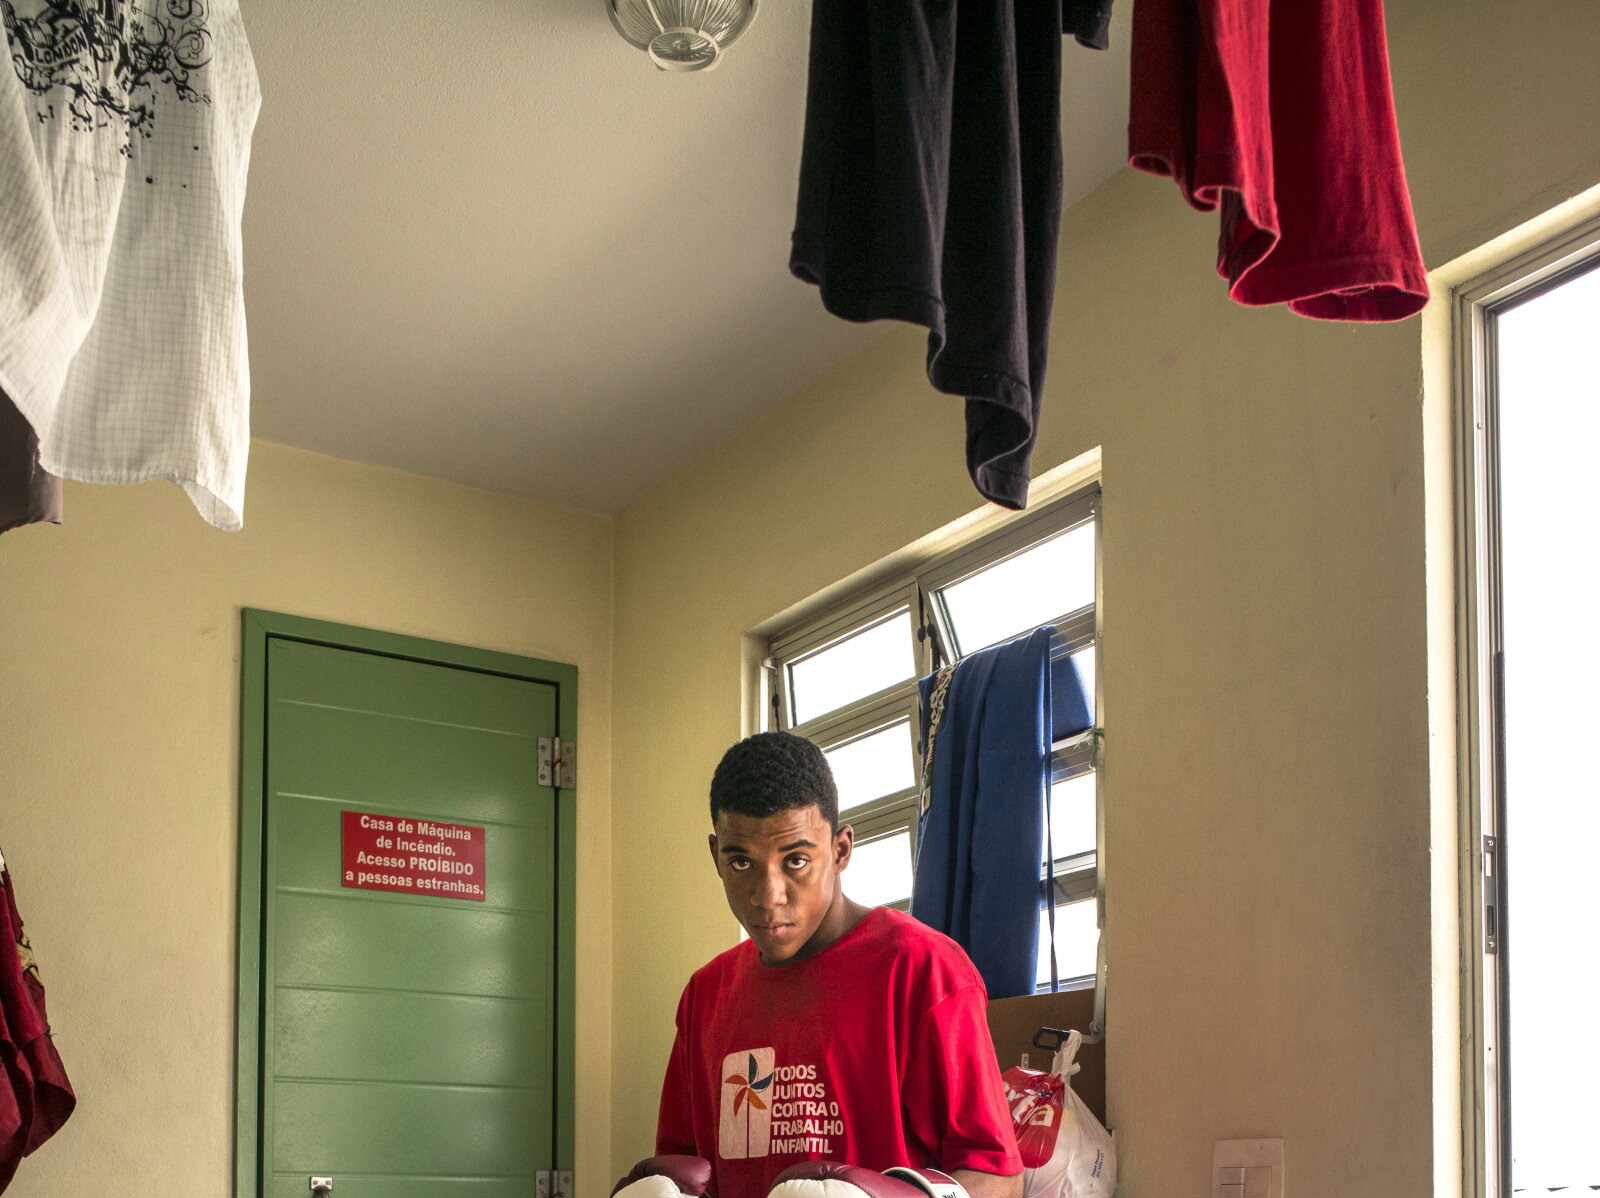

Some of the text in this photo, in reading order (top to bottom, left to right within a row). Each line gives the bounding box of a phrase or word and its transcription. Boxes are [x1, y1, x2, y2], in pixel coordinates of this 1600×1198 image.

[35, 30, 88, 63] LONDON
[360, 815, 471, 841] Casa de Máquina
[376, 835, 456, 856] de Incêndio.
[356, 851, 474, 876] Acesso PROÍBIDO
[345, 870, 484, 895] a pessoas estranhas.
[771, 1118, 844, 1136] TRABALHO
[771, 1137, 833, 1154] INFANTIL
